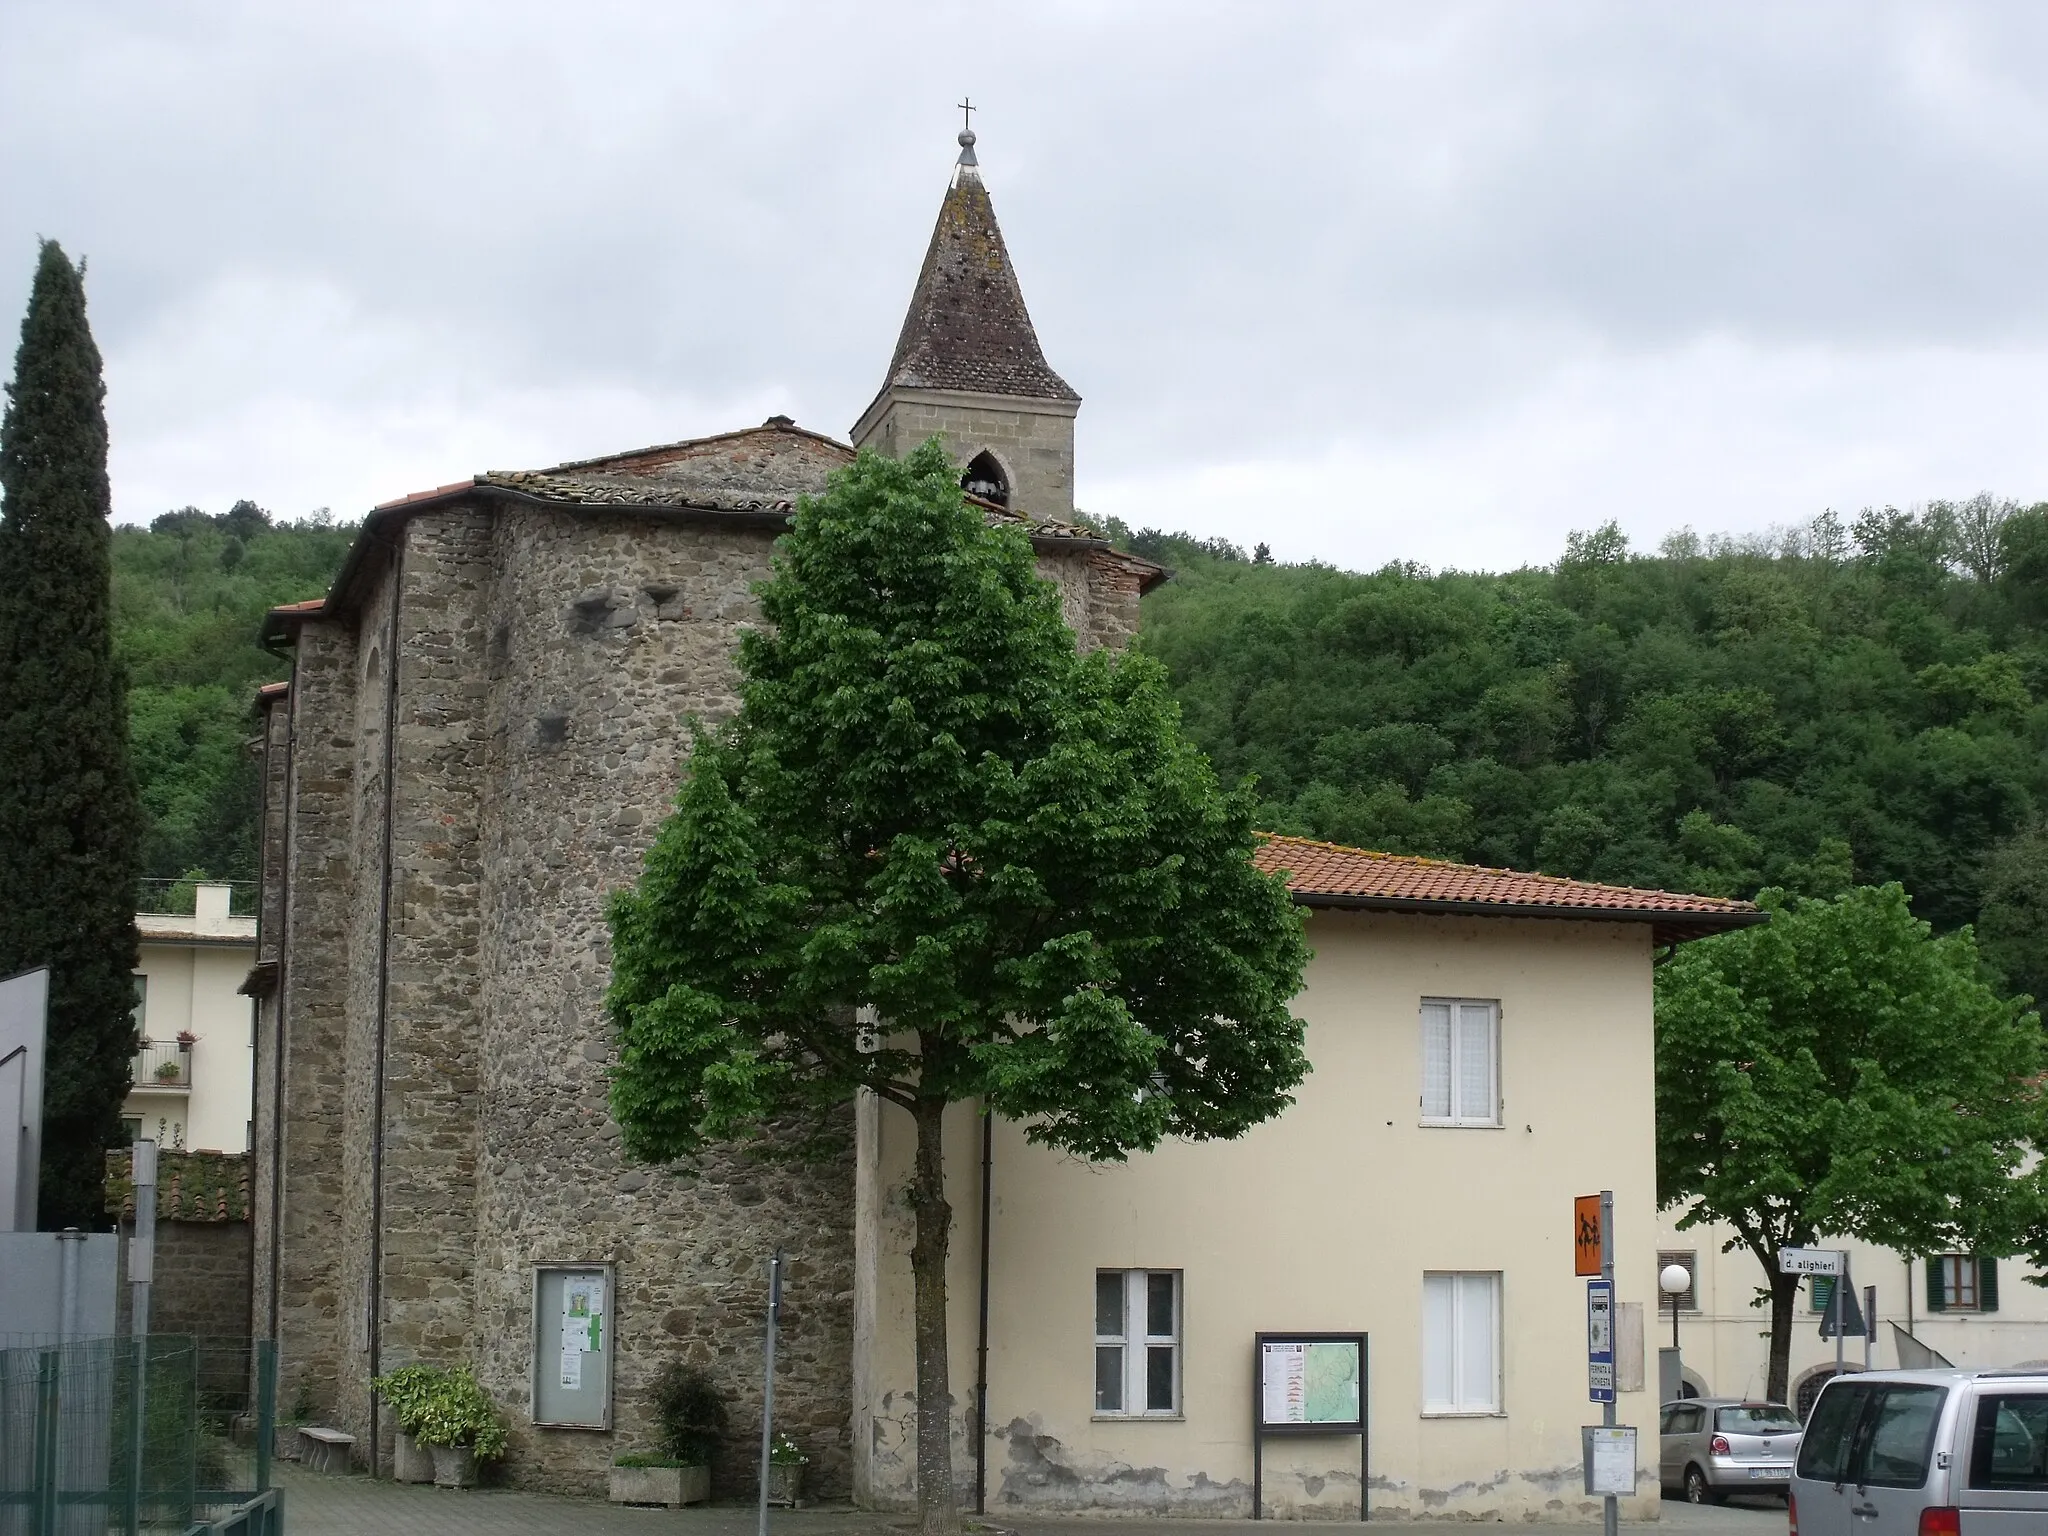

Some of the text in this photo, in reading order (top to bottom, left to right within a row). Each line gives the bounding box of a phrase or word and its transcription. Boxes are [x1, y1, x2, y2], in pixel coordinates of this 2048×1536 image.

[1786, 1260, 1835, 1271] d. alighieri
[1590, 1364, 1607, 1374] FERMATA
[1591, 1377, 1611, 1386] RICHIESTA
